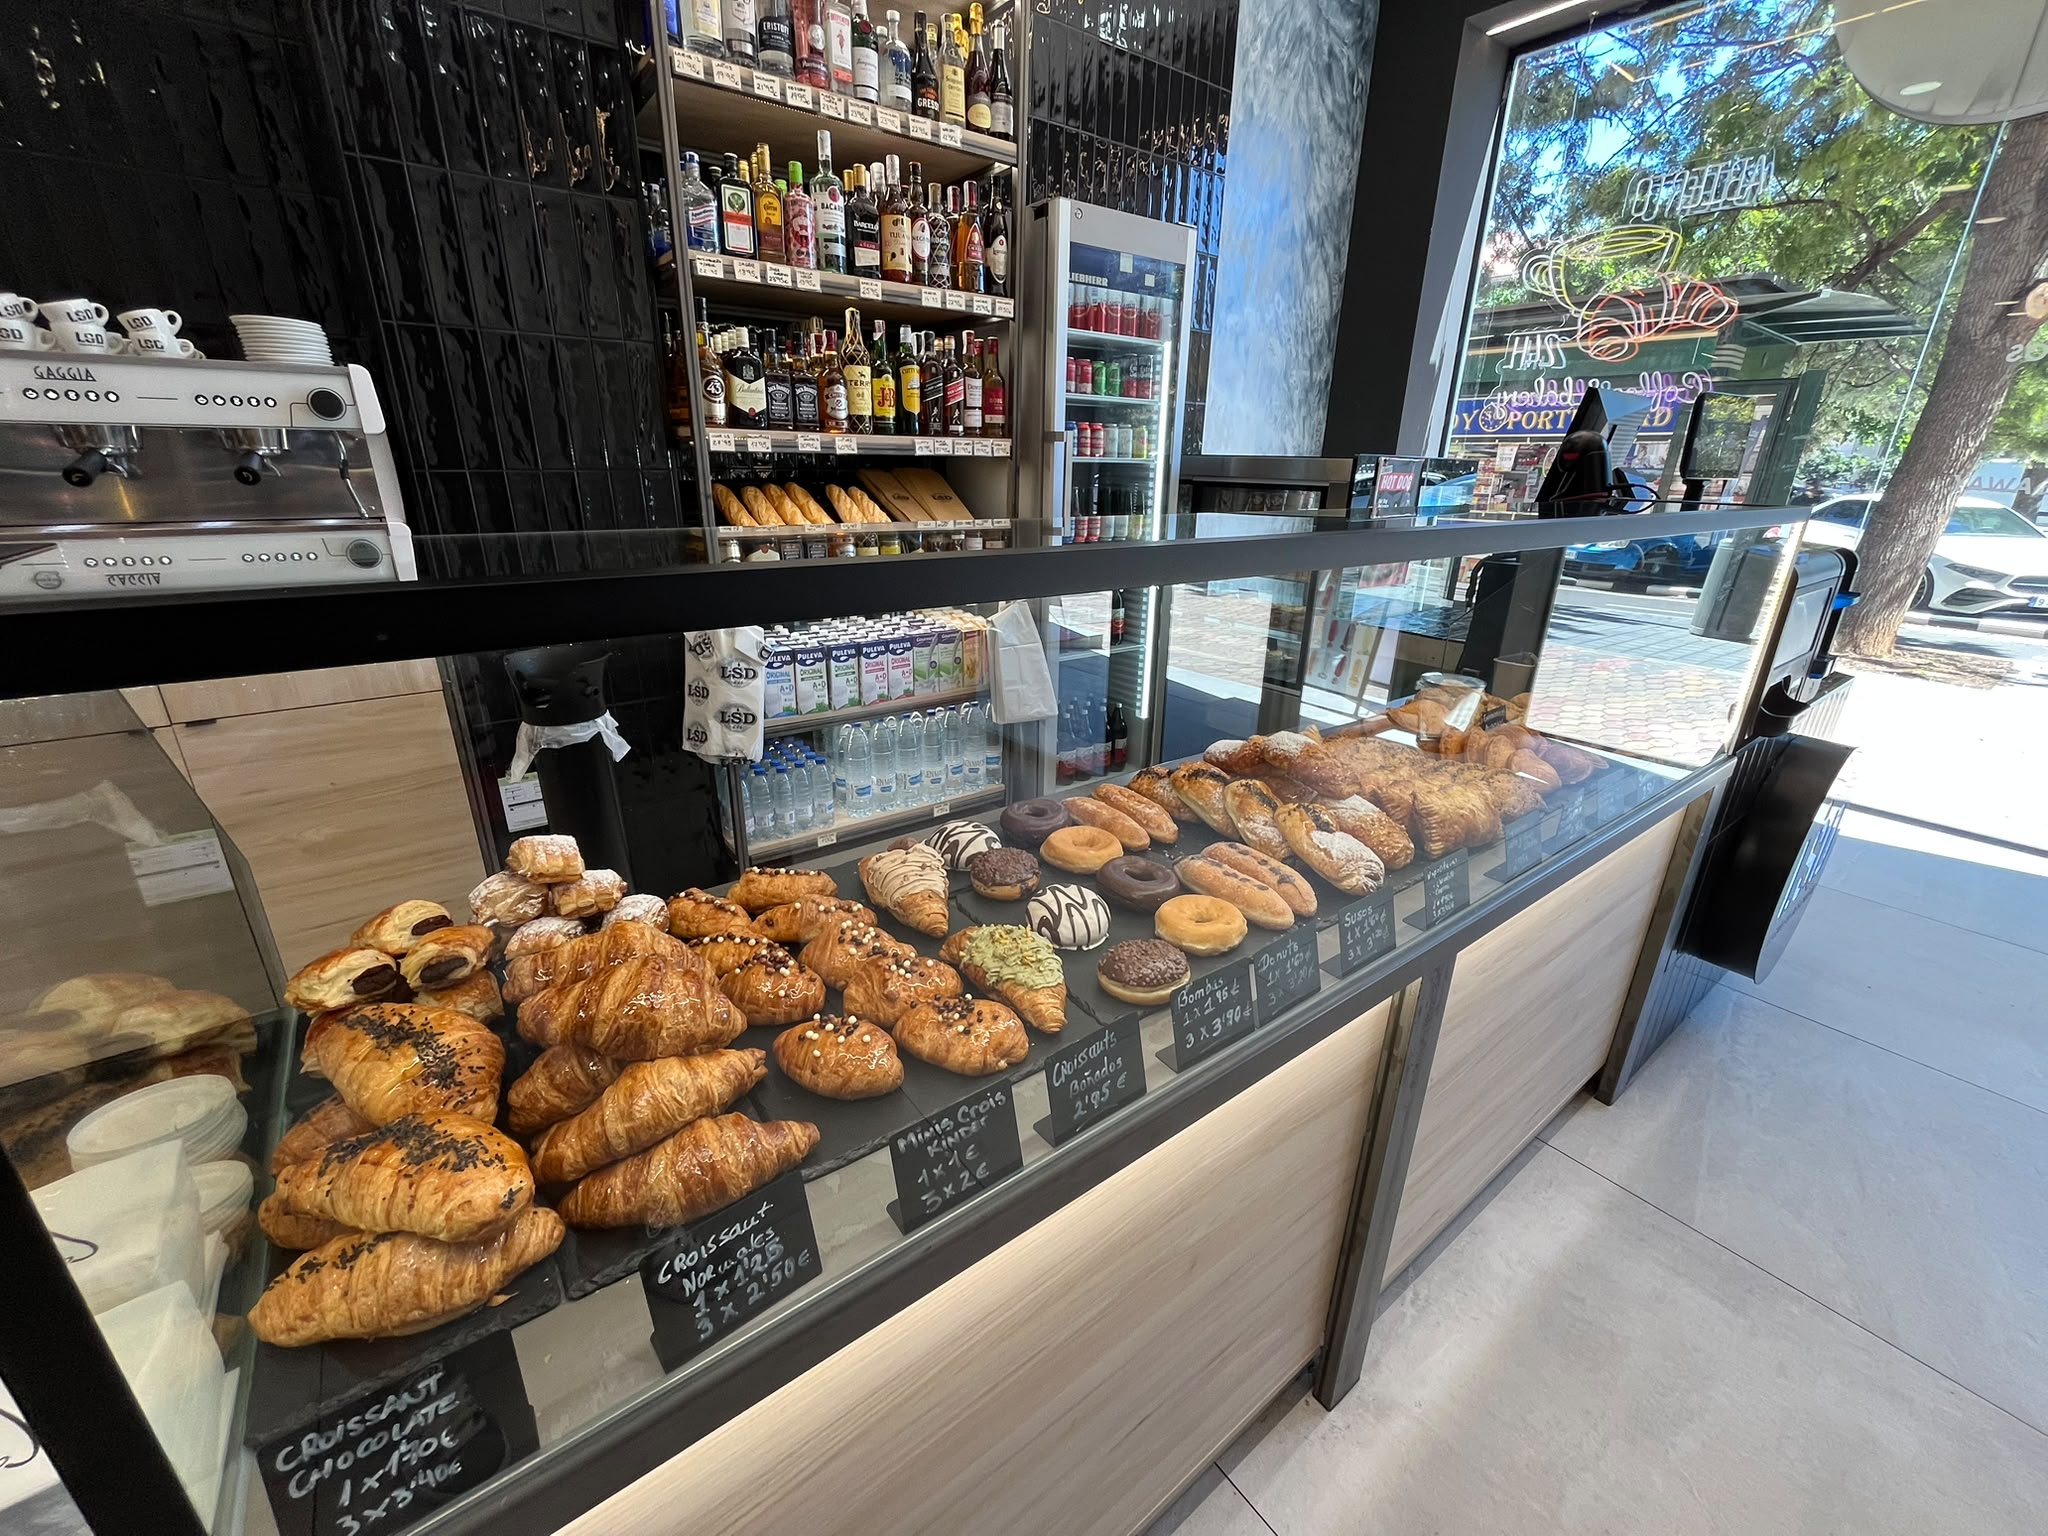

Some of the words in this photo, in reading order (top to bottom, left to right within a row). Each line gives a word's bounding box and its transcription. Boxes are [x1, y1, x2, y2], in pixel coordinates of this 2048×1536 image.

[66, 308, 94, 323] LSD
[127, 315, 153, 329] LSD
[0, 327, 23, 340] SD
[75, 331, 104, 345] LSD
[33, 364, 97, 381] GAGGIA
[706, 381, 722, 394] 43
[1381, 475, 1398, 490] HOT
[1397, 475, 1413, 491] DOG
[863, 645, 886, 654] PULEVA
[889, 641, 912, 650] PULEVA
[769, 654, 791, 662] ULEVA
[797, 651, 823, 660] PULEVA
[832, 649, 856, 657] PULEVA
[720, 666, 757, 680] LSD
[688, 684, 710, 699] LSD
[719, 710, 757, 725] LSD
[687, 728, 709, 744] LSD
[1258, 939, 1299, 973] Donuts
